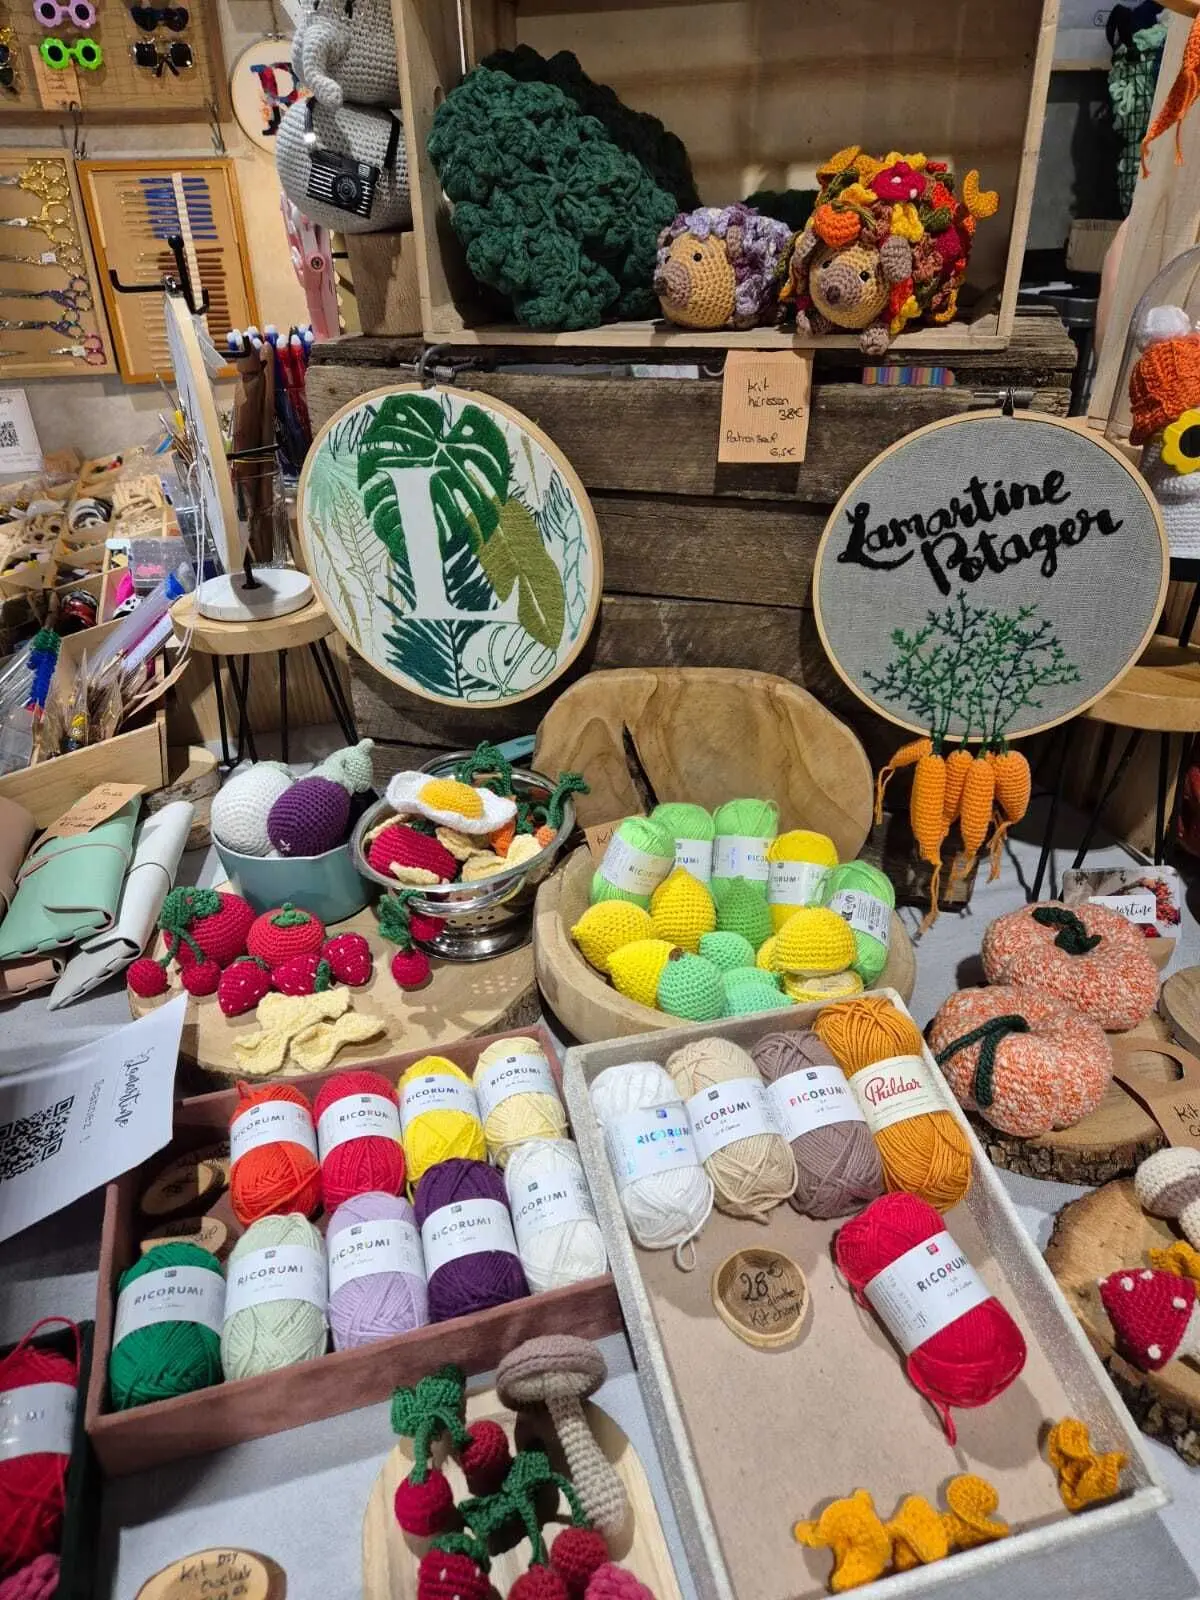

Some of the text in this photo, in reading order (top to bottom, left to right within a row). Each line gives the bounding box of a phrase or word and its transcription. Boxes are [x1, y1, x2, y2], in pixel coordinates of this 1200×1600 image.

[778, 407, 803, 421] 38€
[837, 470, 1071, 571] Lamartine
[921, 508, 1123, 596] Potager
[490, 1067, 541, 1087] RICORUMI
[406, 1086, 459, 1104] RICORUMI
[864, 1076, 922, 1107] Phildar
[695, 1101, 751, 1131] RICORUMI
[515, 1190, 568, 1222] RICORUMI
[431, 1216, 492, 1241] RICORUMI
[331, 1238, 391, 1265] RICORUMI
[237, 1265, 304, 1286] RICORUMI
[134, 1286, 204, 1306] RICORUMI
